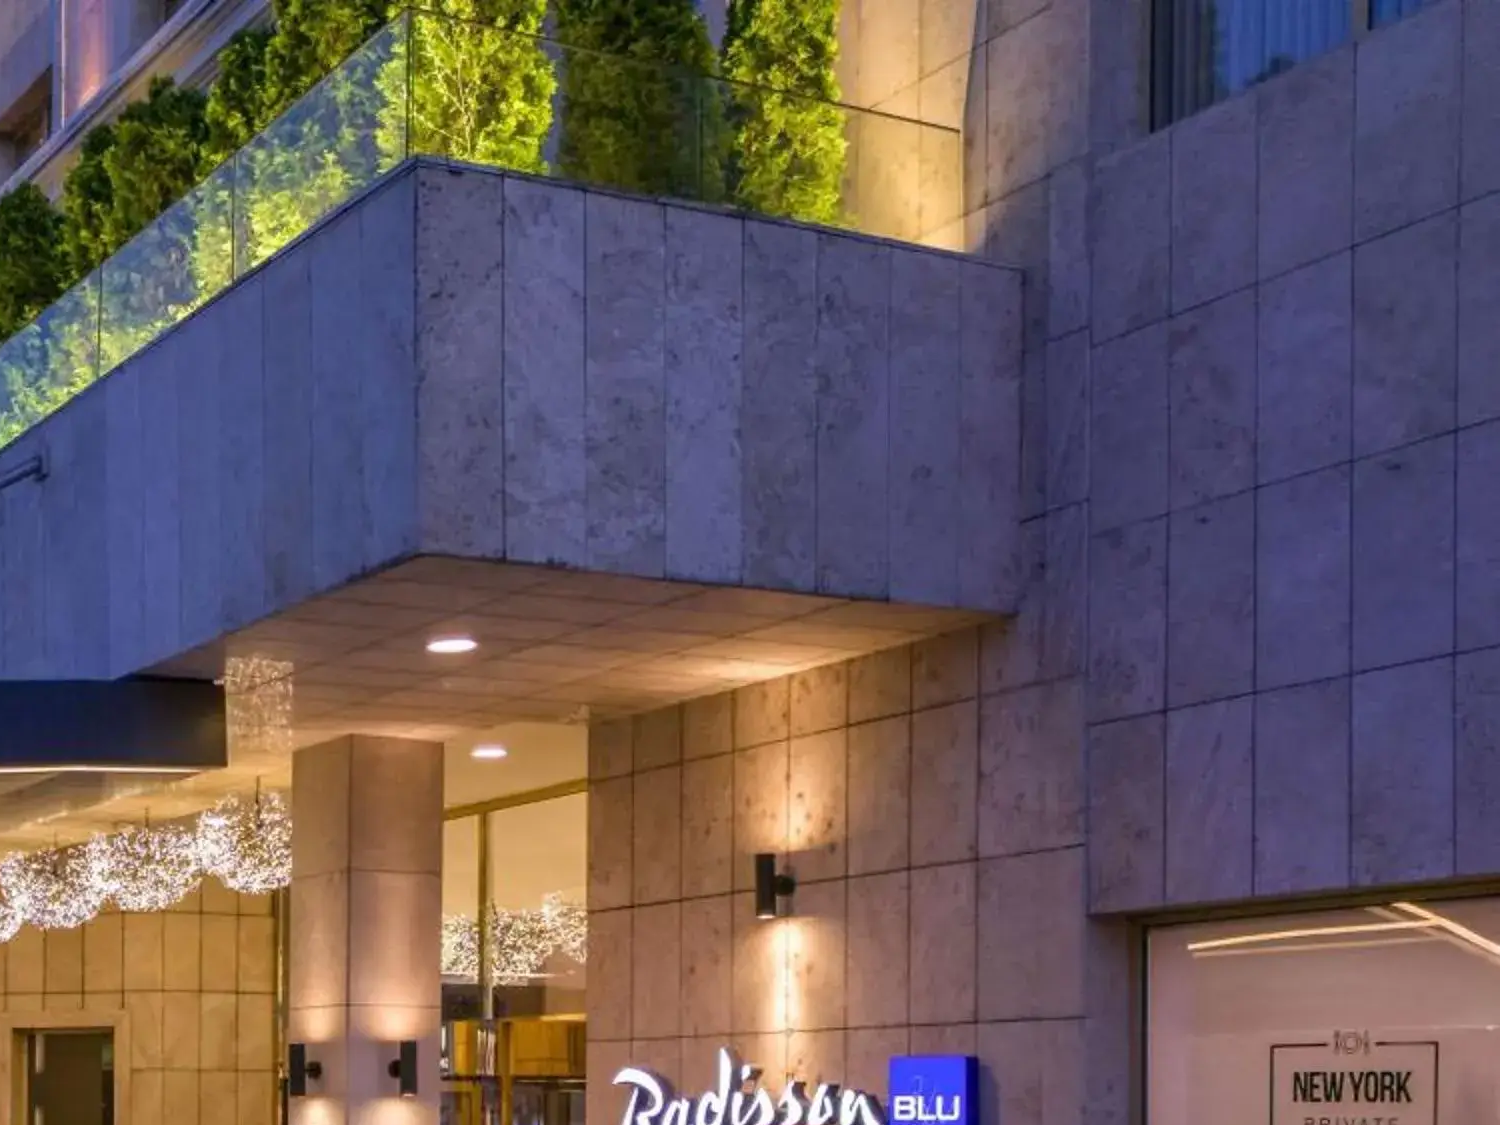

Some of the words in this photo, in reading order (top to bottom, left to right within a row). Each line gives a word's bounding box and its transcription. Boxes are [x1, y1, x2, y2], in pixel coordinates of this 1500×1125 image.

[1292, 1071, 1345, 1103] NEW
[1349, 1071, 1413, 1103] YORK
[894, 1094, 961, 1121] BLU
